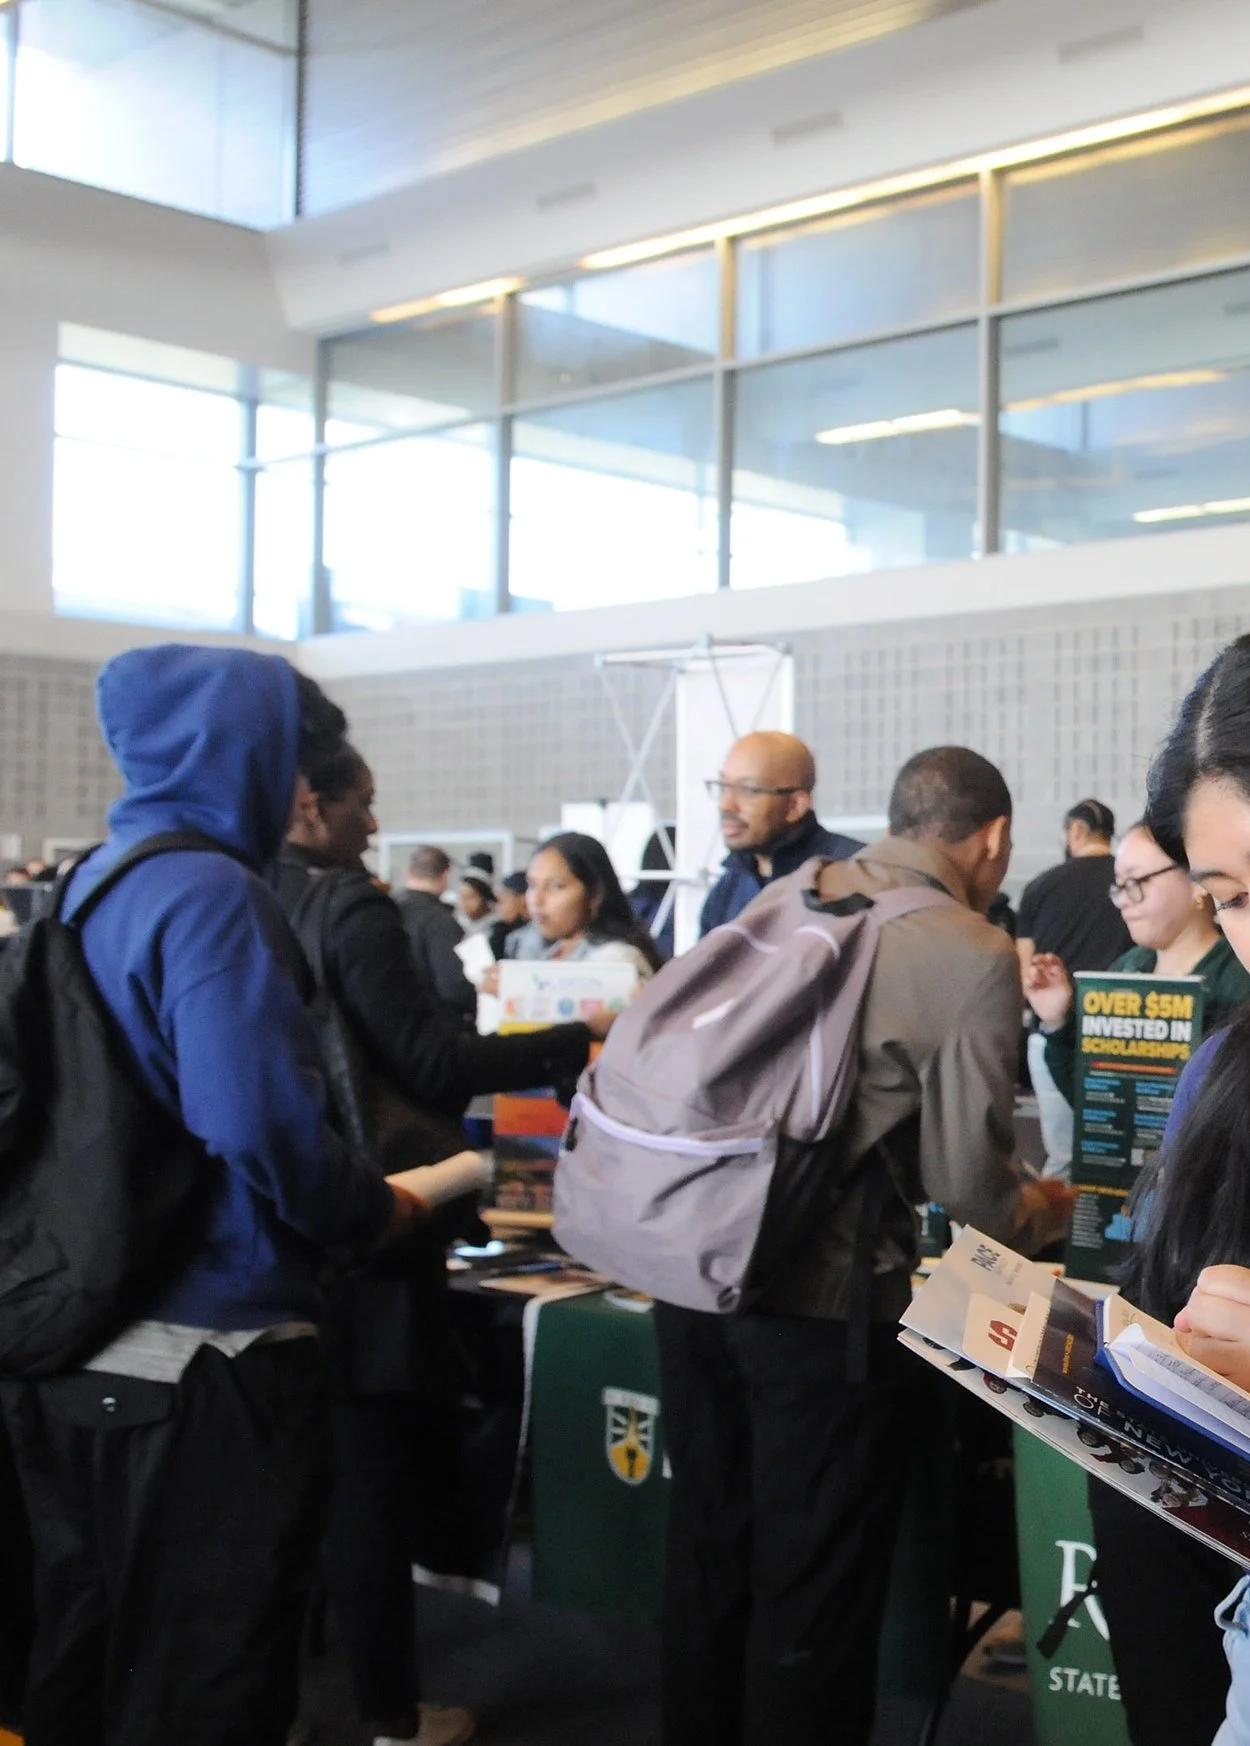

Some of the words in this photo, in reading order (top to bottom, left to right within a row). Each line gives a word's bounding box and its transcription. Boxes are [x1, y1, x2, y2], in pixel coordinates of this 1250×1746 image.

[1083, 991, 1142, 1016] OVER
[1145, 991, 1194, 1019] $5M
[1082, 1015, 1169, 1040] INVESTED
[1170, 1020, 1192, 1042] IN
[1082, 1036, 1190, 1060] SCHOLARSHIPS
[1076, 1386, 1110, 1409] THE
[1073, 1393, 1112, 1417] OF
[1123, 1421, 1200, 1464] NEW
[1049, 1667, 1122, 1701] STATE
